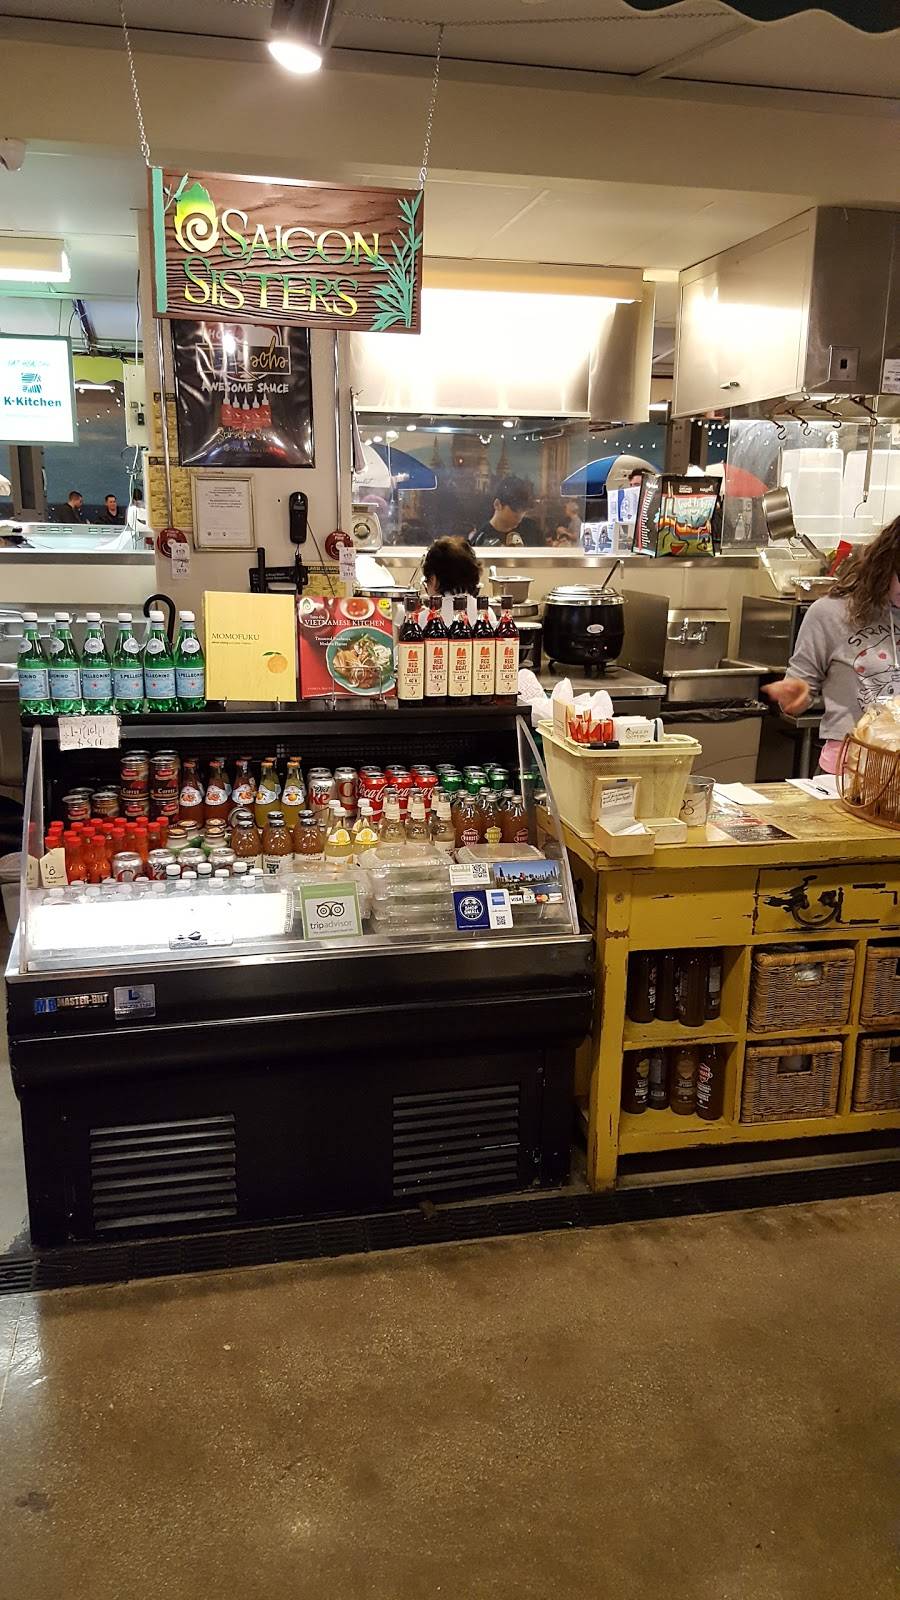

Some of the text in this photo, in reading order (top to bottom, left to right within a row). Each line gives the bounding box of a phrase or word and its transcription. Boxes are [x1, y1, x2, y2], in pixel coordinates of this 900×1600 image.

[221, 208, 380, 266] SAIGON
[183, 255, 359, 317] SISTERS
[201, 381, 289, 394] AWESOME SAUCE
[305, 619, 385, 627] VIETNAMESE KITCHEN
[211, 633, 260, 641] MOMOFUKU
[310, 920, 352, 930] tripadvisor
